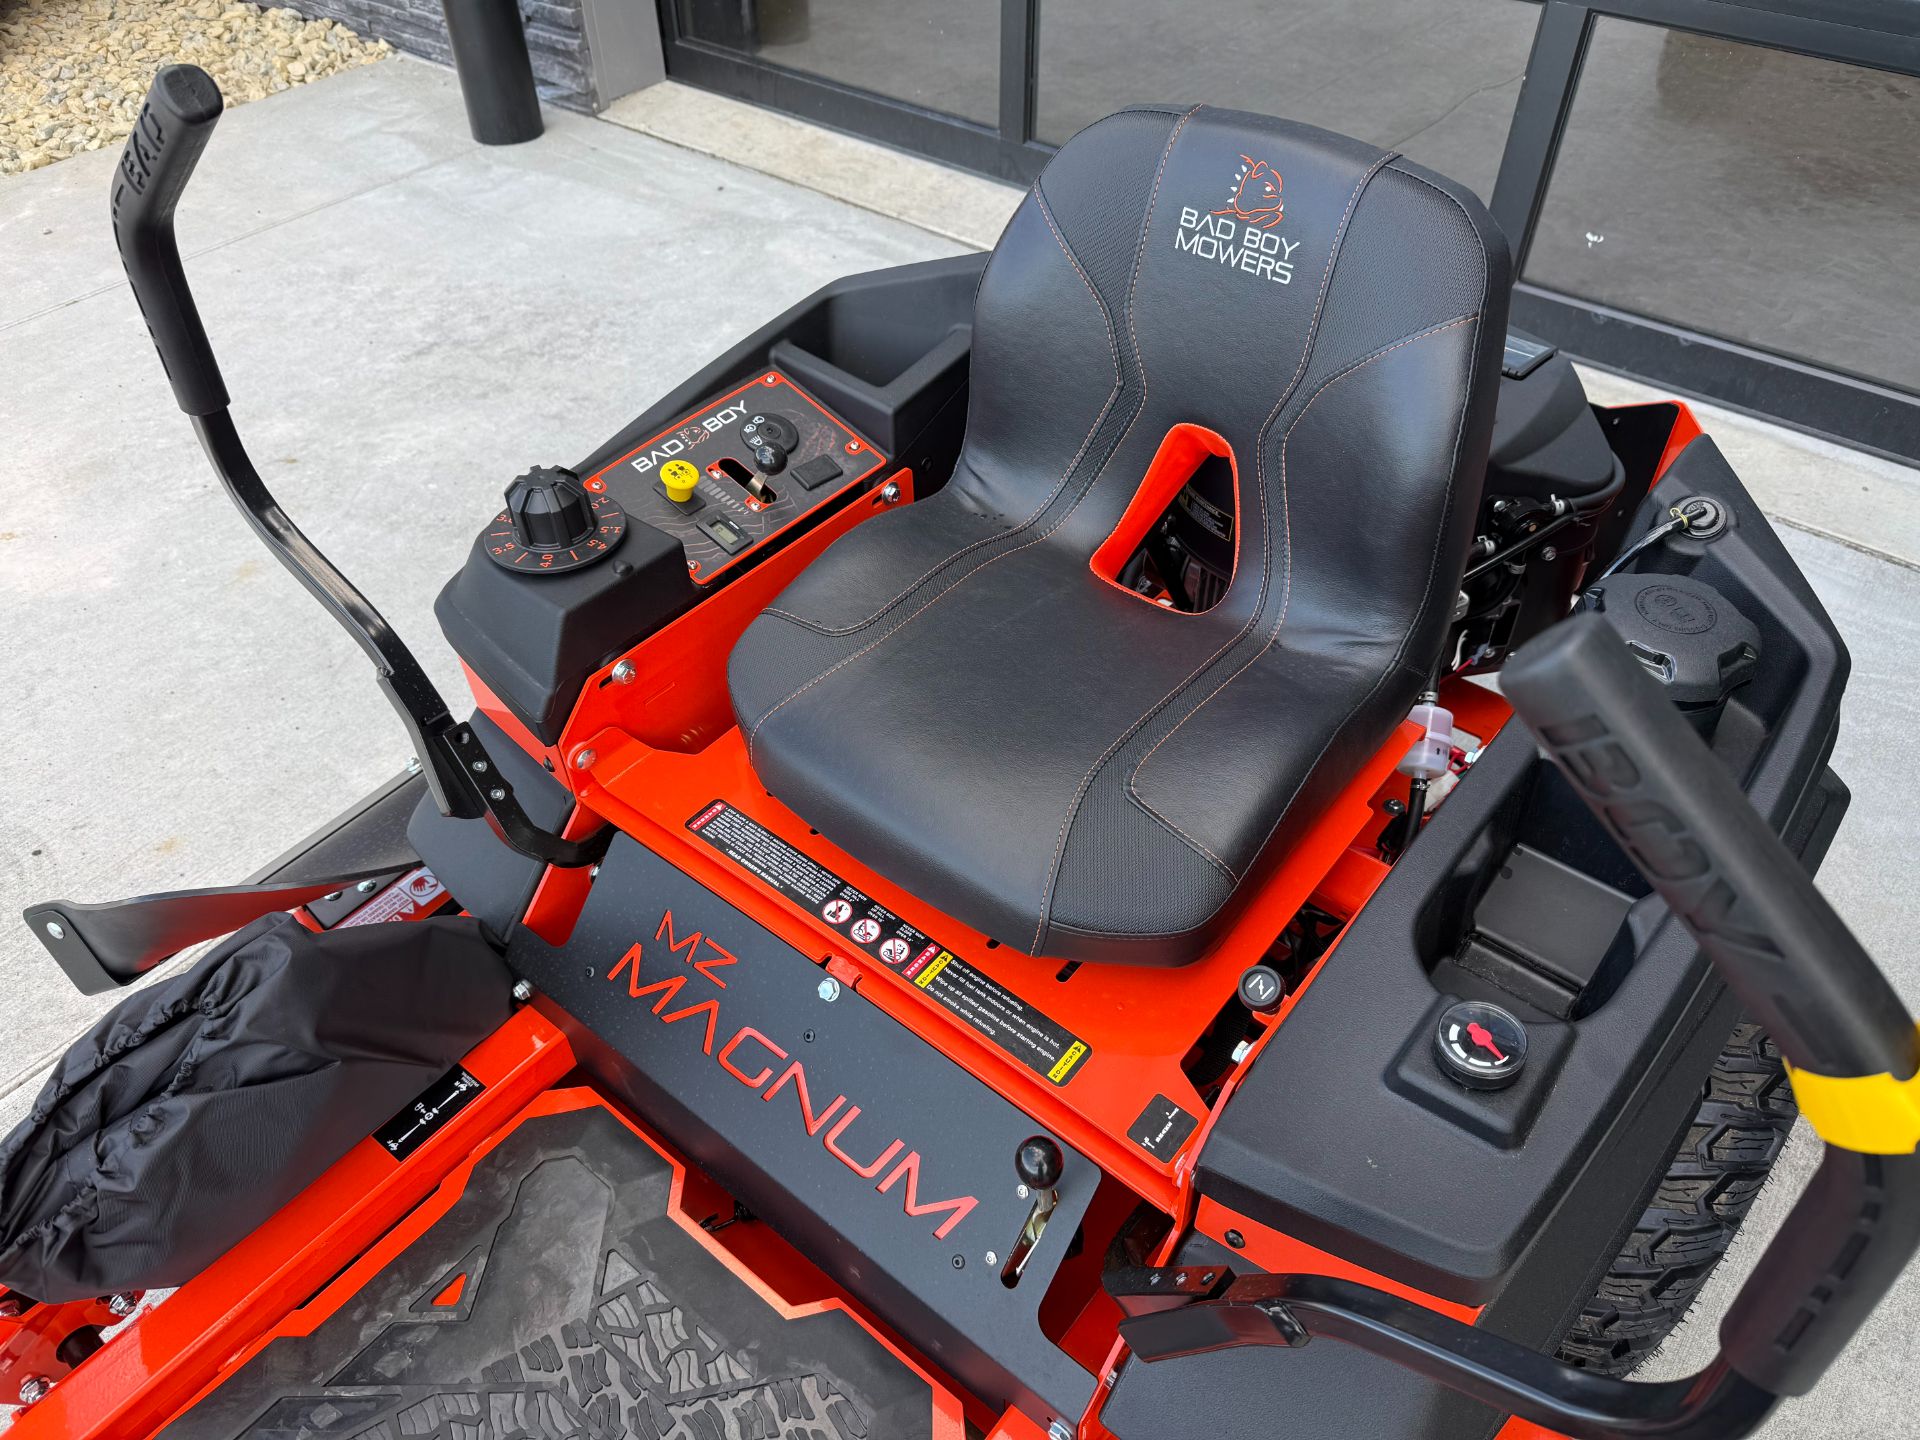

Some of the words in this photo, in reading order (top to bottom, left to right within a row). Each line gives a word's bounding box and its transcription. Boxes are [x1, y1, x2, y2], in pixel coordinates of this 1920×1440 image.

[1174, 227, 1294, 285] MOWERS
[1180, 206, 1236, 240] BAD
[1243, 227, 1300, 260] BOY
[630, 438, 685, 473] BAD
[702, 399, 748, 433] BOY
[492, 542, 516, 555] 3.5
[600, 525, 622, 534] 1.5
[540, 553, 554, 568] 4.0
[655, 909, 738, 989] MZ
[906, 952, 930, 975] DANGER
[918, 960, 943, 985] CAUTION
[926, 984, 935, 992] Do
[934, 990, 944, 998] not
[943, 997, 960, 1009] smoke
[960, 1008, 973, 1019] while
[973, 1017, 995, 1035] refueling.
[944, 967, 959, 978] Never
[965, 981, 976, 990] fuel
[986, 996, 1005, 1011] indoors
[1012, 1014, 1026, 1025] when
[1026, 1024, 1044, 1037] engine
[1049, 1039, 1059, 1049] hot.
[951, 960, 963, 969] Shut
[969, 973, 986, 985] engine
[985, 983, 1001, 996] before
[1001, 994, 1023, 1011] refueling.
[936, 976, 948, 986] Wipe
[962, 995, 979, 1007] spilled
[977, 1006, 1000, 1022] gasoline
[999, 1020, 1017, 1034] before
[1016, 1032, 1037, 1048] starting
[1037, 1047, 1055, 1062] engine.
[1052, 1051, 1077, 1079] CAUTION
[607, 942, 980, 1240] MAGNUM
